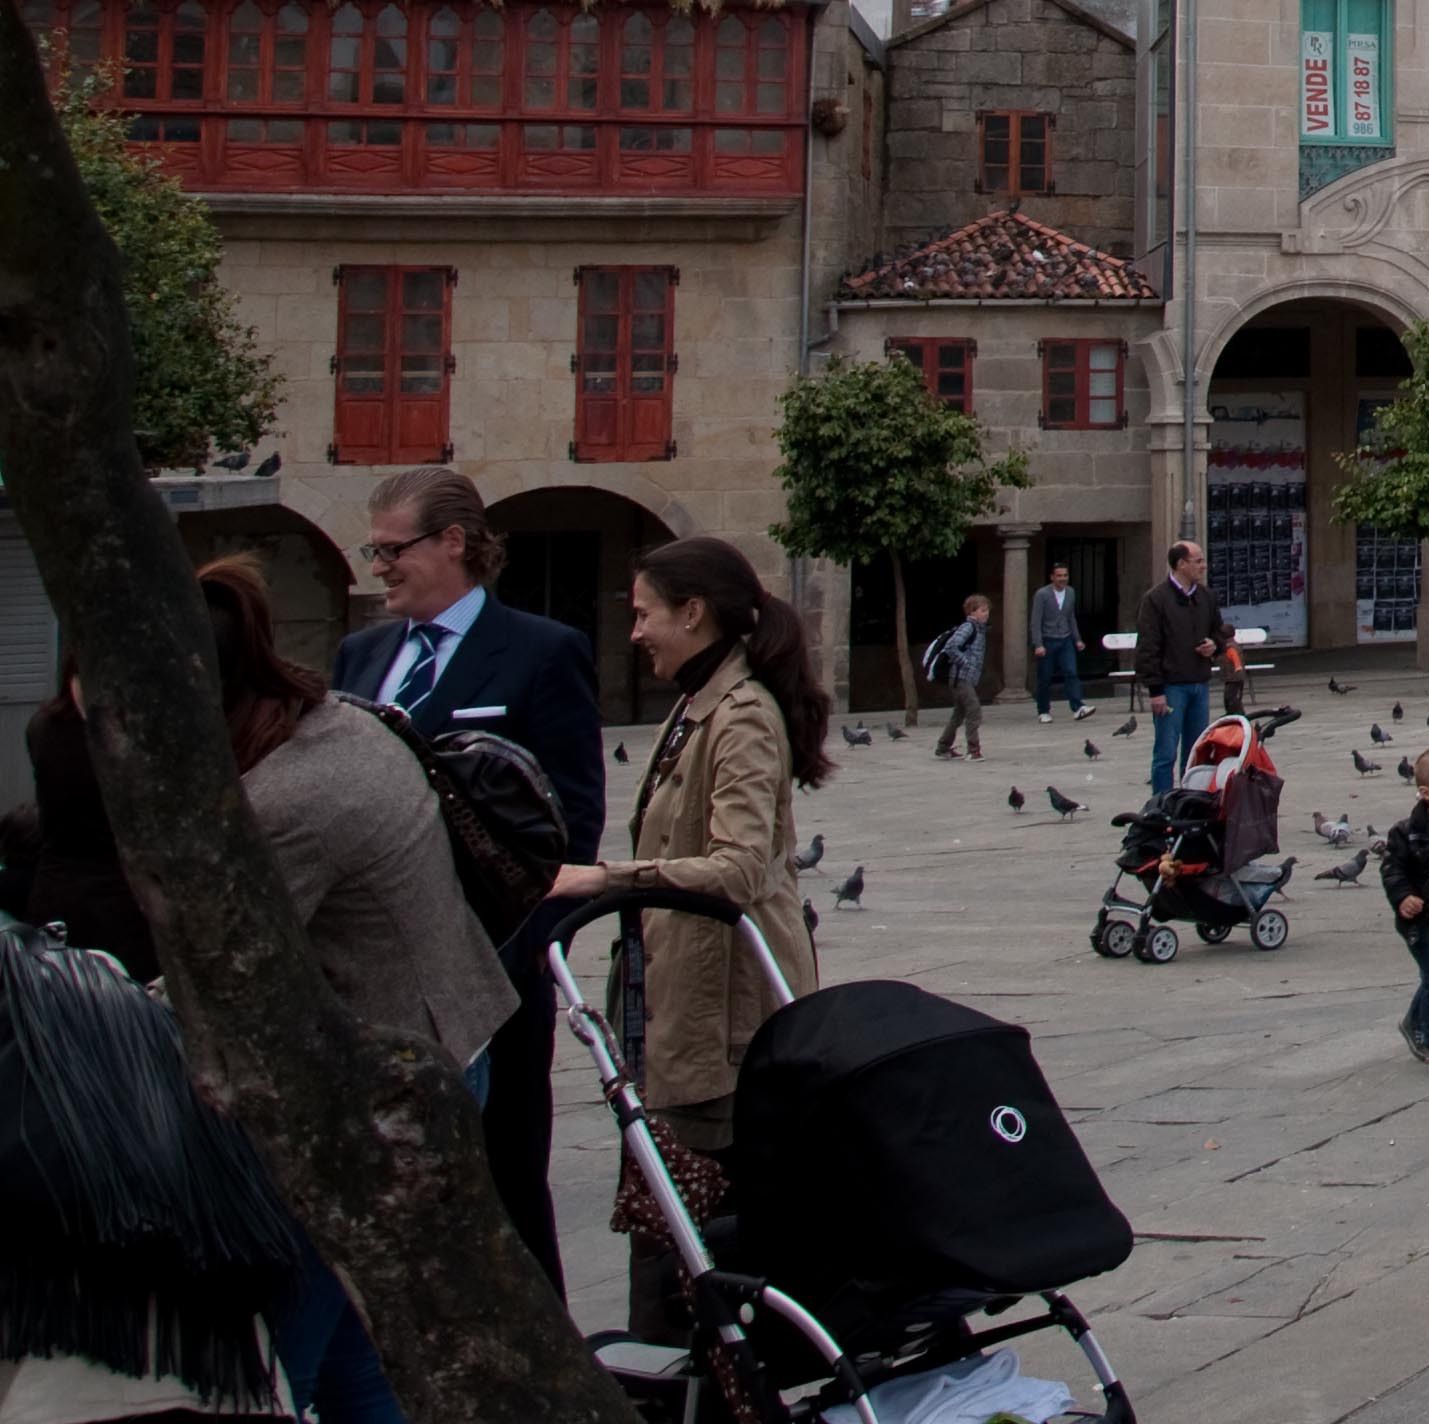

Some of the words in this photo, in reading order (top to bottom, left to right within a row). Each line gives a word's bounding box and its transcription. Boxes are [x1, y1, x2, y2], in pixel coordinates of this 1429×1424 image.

[1353, 57, 1370, 76] 87
[1305, 59, 1329, 132] VENDE
[1354, 80, 1370, 97] 18
[1354, 102, 1371, 121] 87
[1353, 123, 1373, 135] 986
